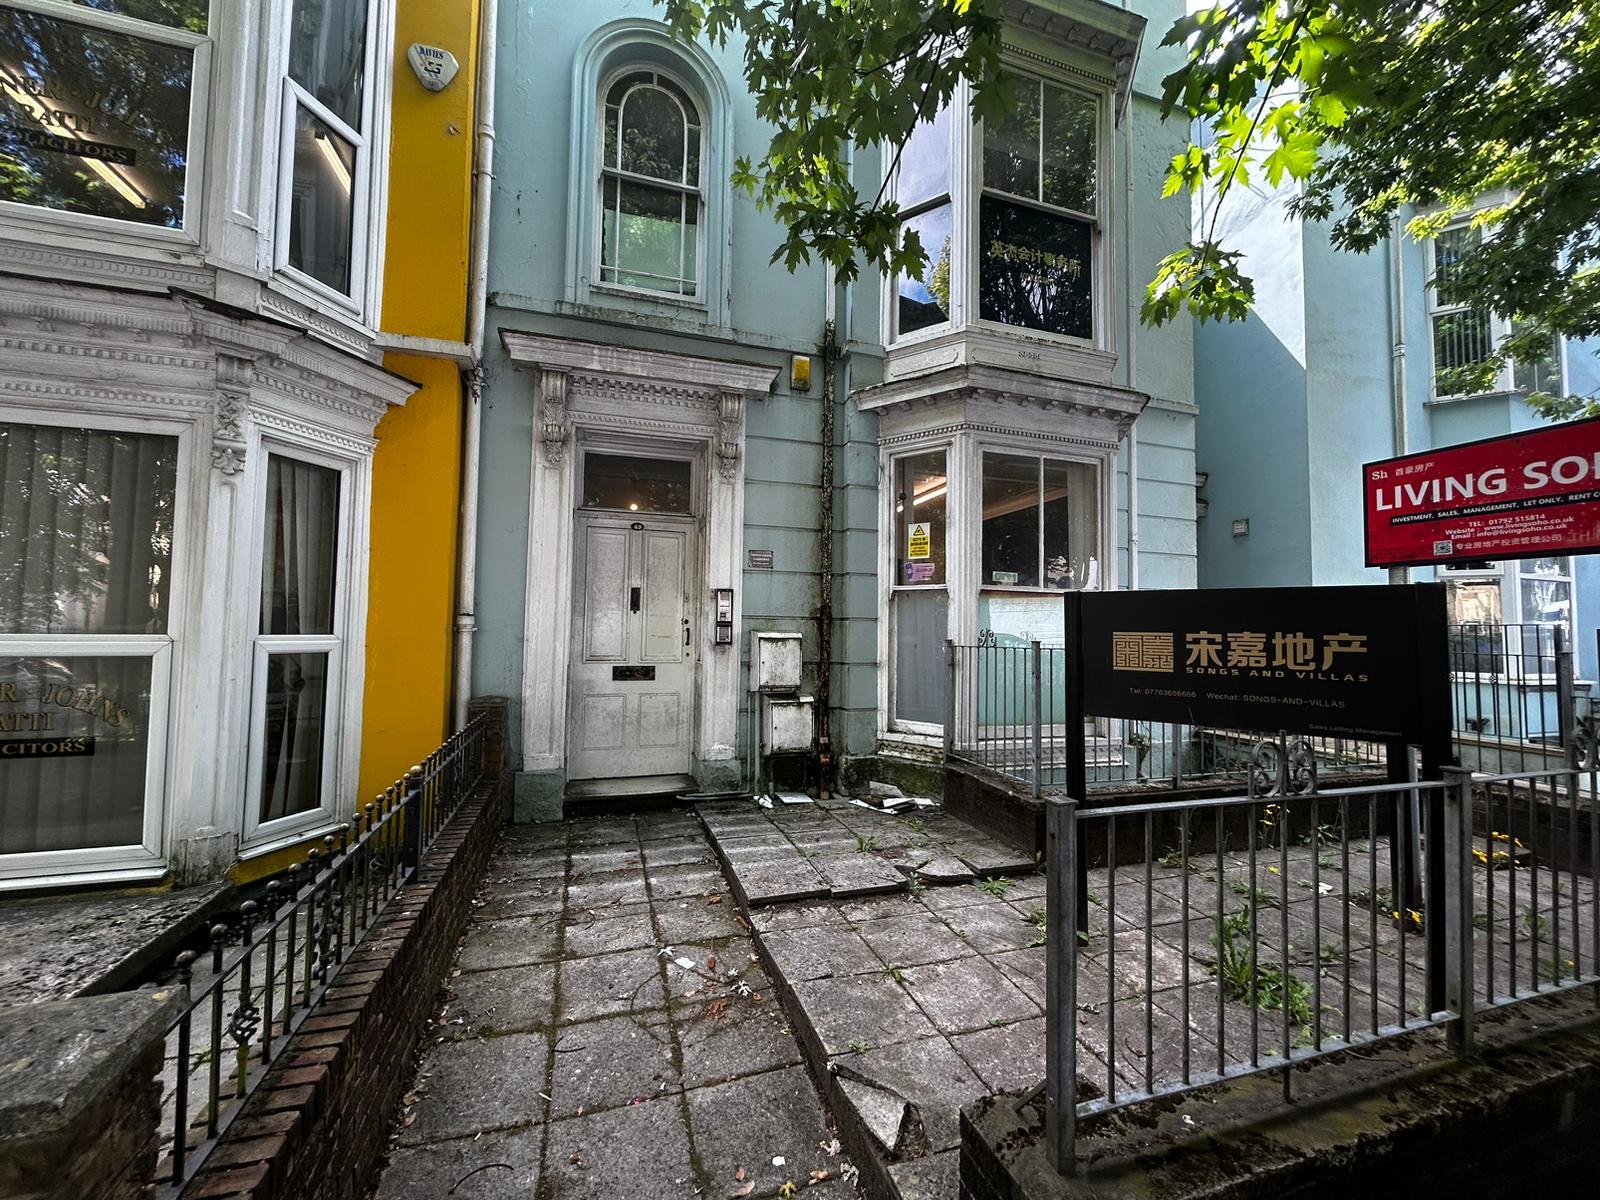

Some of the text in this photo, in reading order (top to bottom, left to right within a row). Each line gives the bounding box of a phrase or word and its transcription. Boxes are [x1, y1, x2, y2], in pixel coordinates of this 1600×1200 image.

[1375, 451, 1600, 511] LIVING SO
[1523, 498, 1537, 506] LET
[1568, 492, 1590, 501] RENT
[1488, 516, 1513, 526] 01792
[1515, 513, 1546, 523] 515814
[1186, 630, 1368, 672] 宋嘉地产
[1185, 667, 1369, 682] SONGS AND VILLAS
